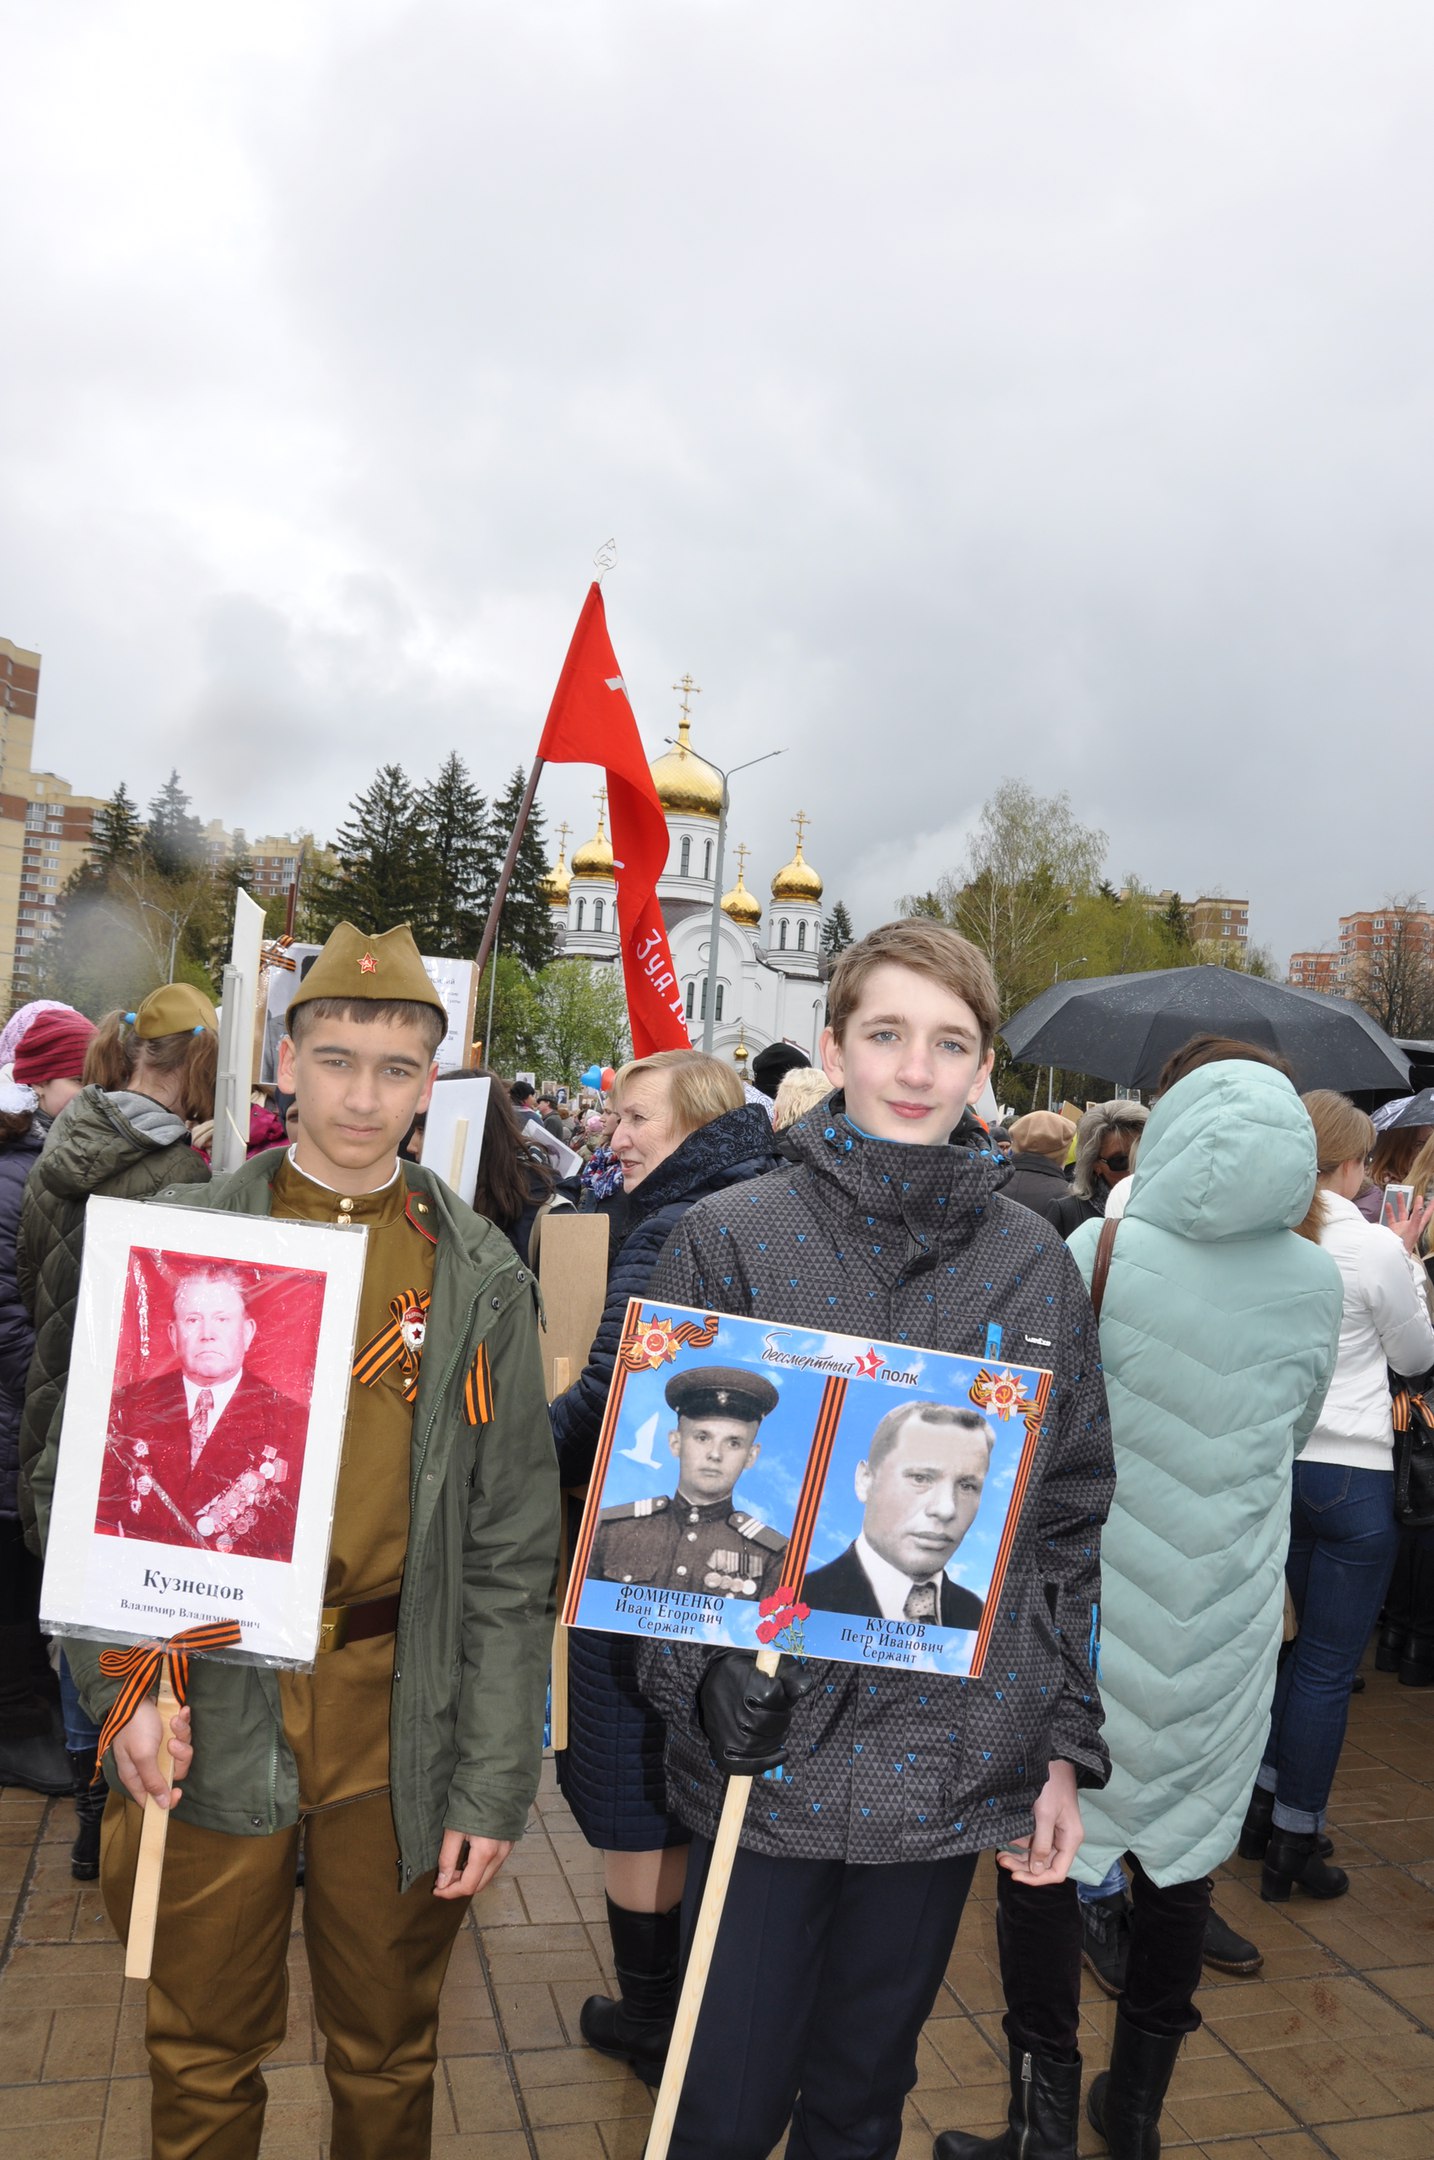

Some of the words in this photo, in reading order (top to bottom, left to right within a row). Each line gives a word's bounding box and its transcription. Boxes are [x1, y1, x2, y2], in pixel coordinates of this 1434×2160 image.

[143, 1569, 244, 1601] Кузнецов
[620, 1586, 724, 1611] ФОМИЧЕНКО
[120, 1599, 176, 1617] Владимир
[179, 1608, 260, 1629] Владимивич
[615, 1599, 652, 1616] Иван
[658, 1604, 723, 1624] Егорович
[638, 1617, 695, 1635] Сержант
[866, 1618, 926, 1637] КУСКОВ
[841, 1628, 873, 1644] Петр
[879, 1633, 944, 1654] Иванович
[863, 1644, 917, 1663] Сержант
